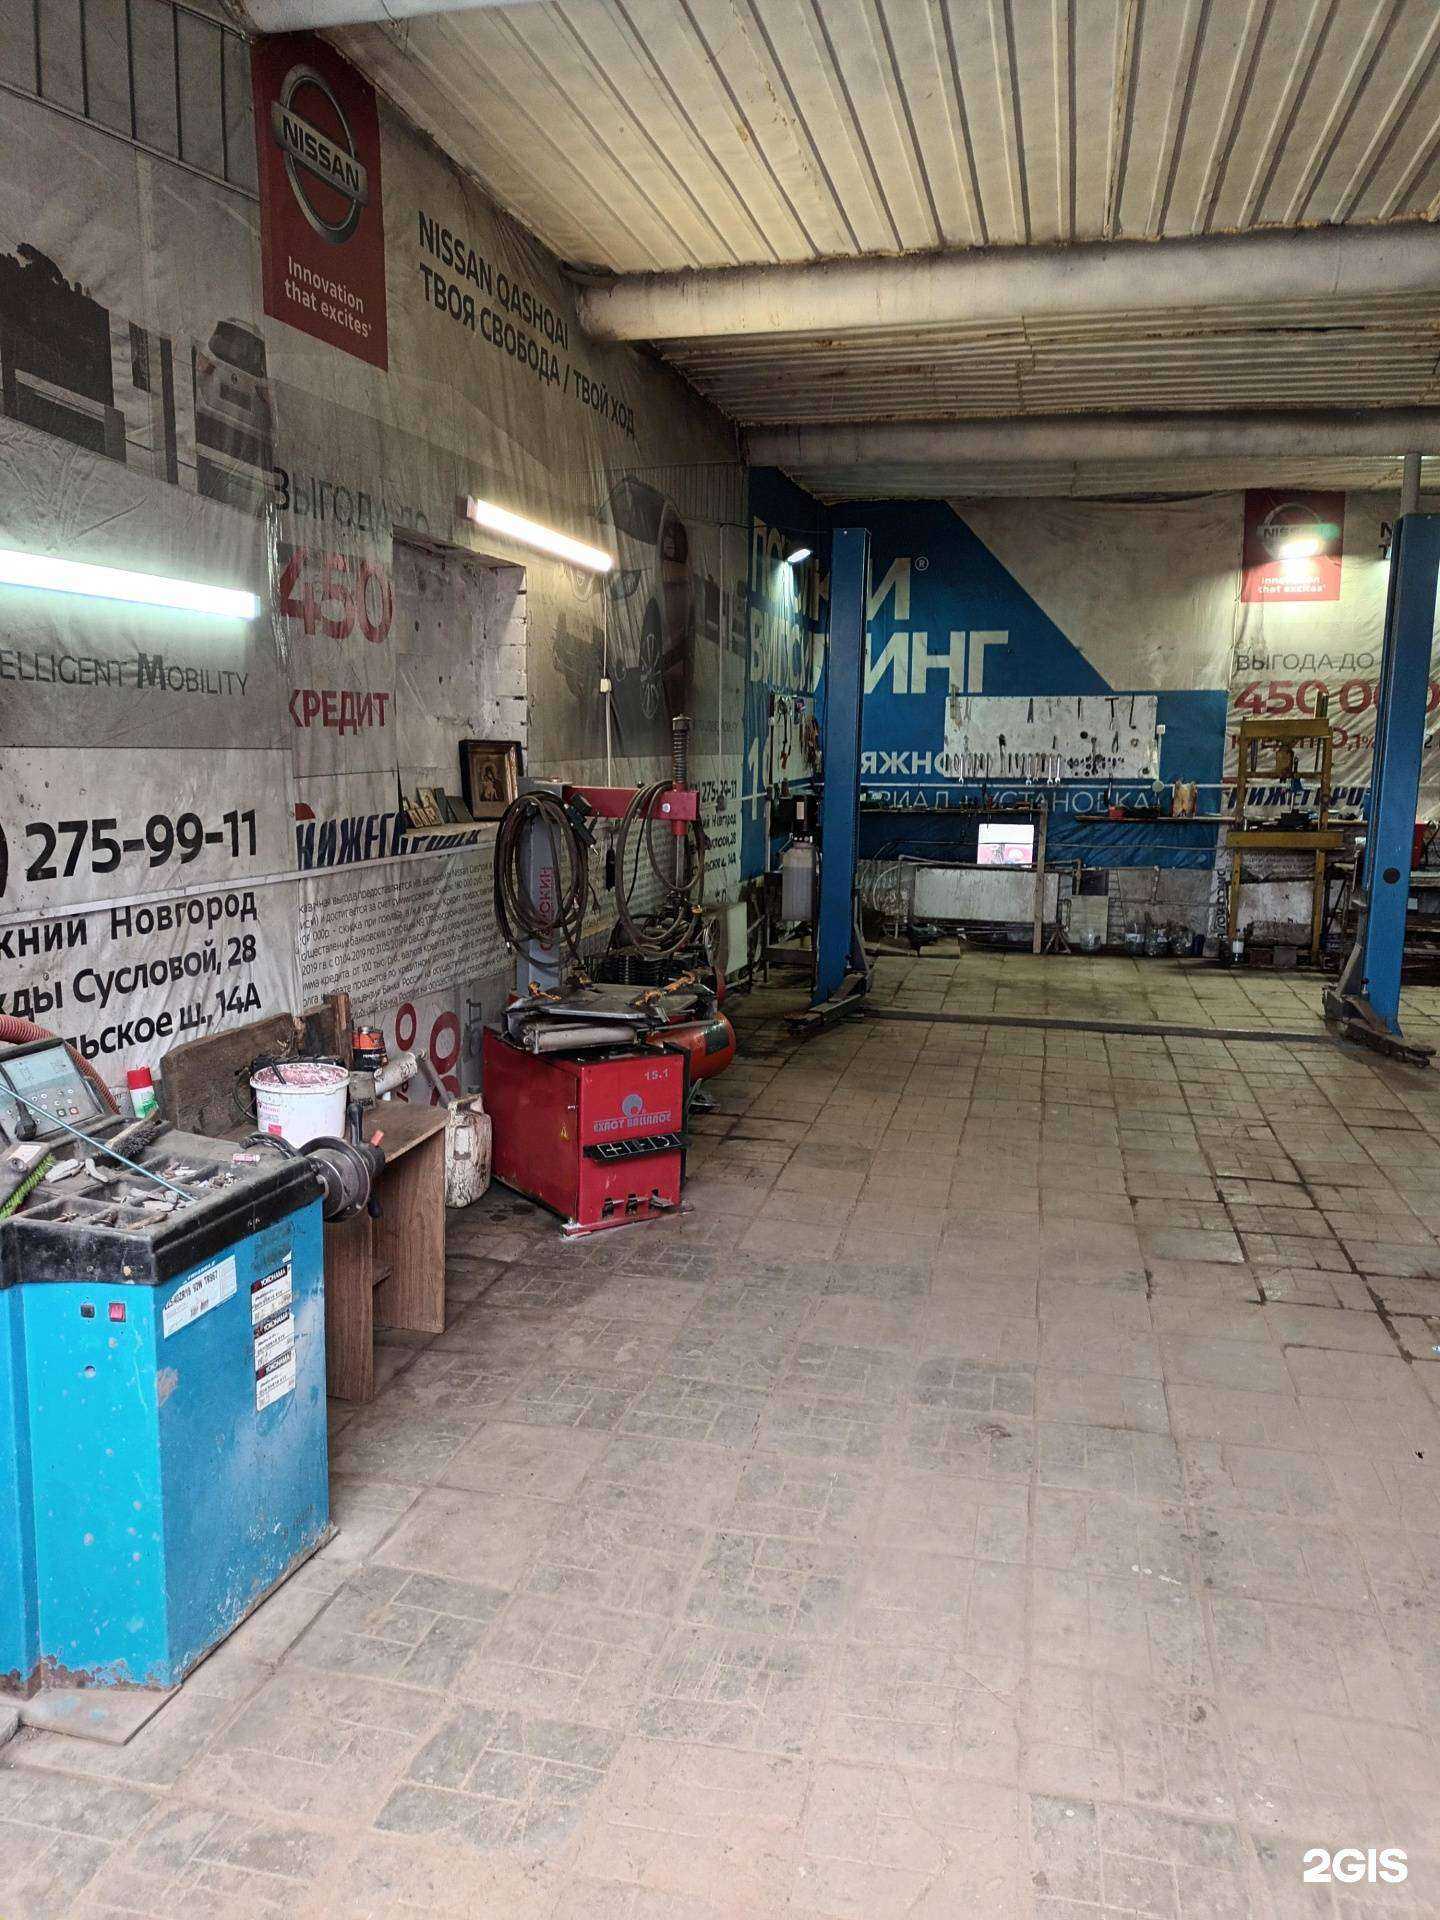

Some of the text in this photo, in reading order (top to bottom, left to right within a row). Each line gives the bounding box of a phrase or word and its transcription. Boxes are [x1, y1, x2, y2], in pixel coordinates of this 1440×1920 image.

[283, 115, 360, 193] NISSAN
[285, 279, 317, 309] that
[288, 256, 364, 314] Innovation
[419, 210, 568, 351] NISSAN QASHQAI
[420, 262, 635, 439] ТВОЯ СВОБОДА / ТВОЙ ХОД
[279, 544, 393, 643] 450
[1234, 679, 1330, 714] 450
[1236, 652, 1375, 672] ВЫГОДА ДО
[25, 809, 257, 882] 275-99-11
[111, 891, 258, 940] Новгород
[73, 938, 222, 1008] Сусловой,
[227, 934, 257, 968] 28
